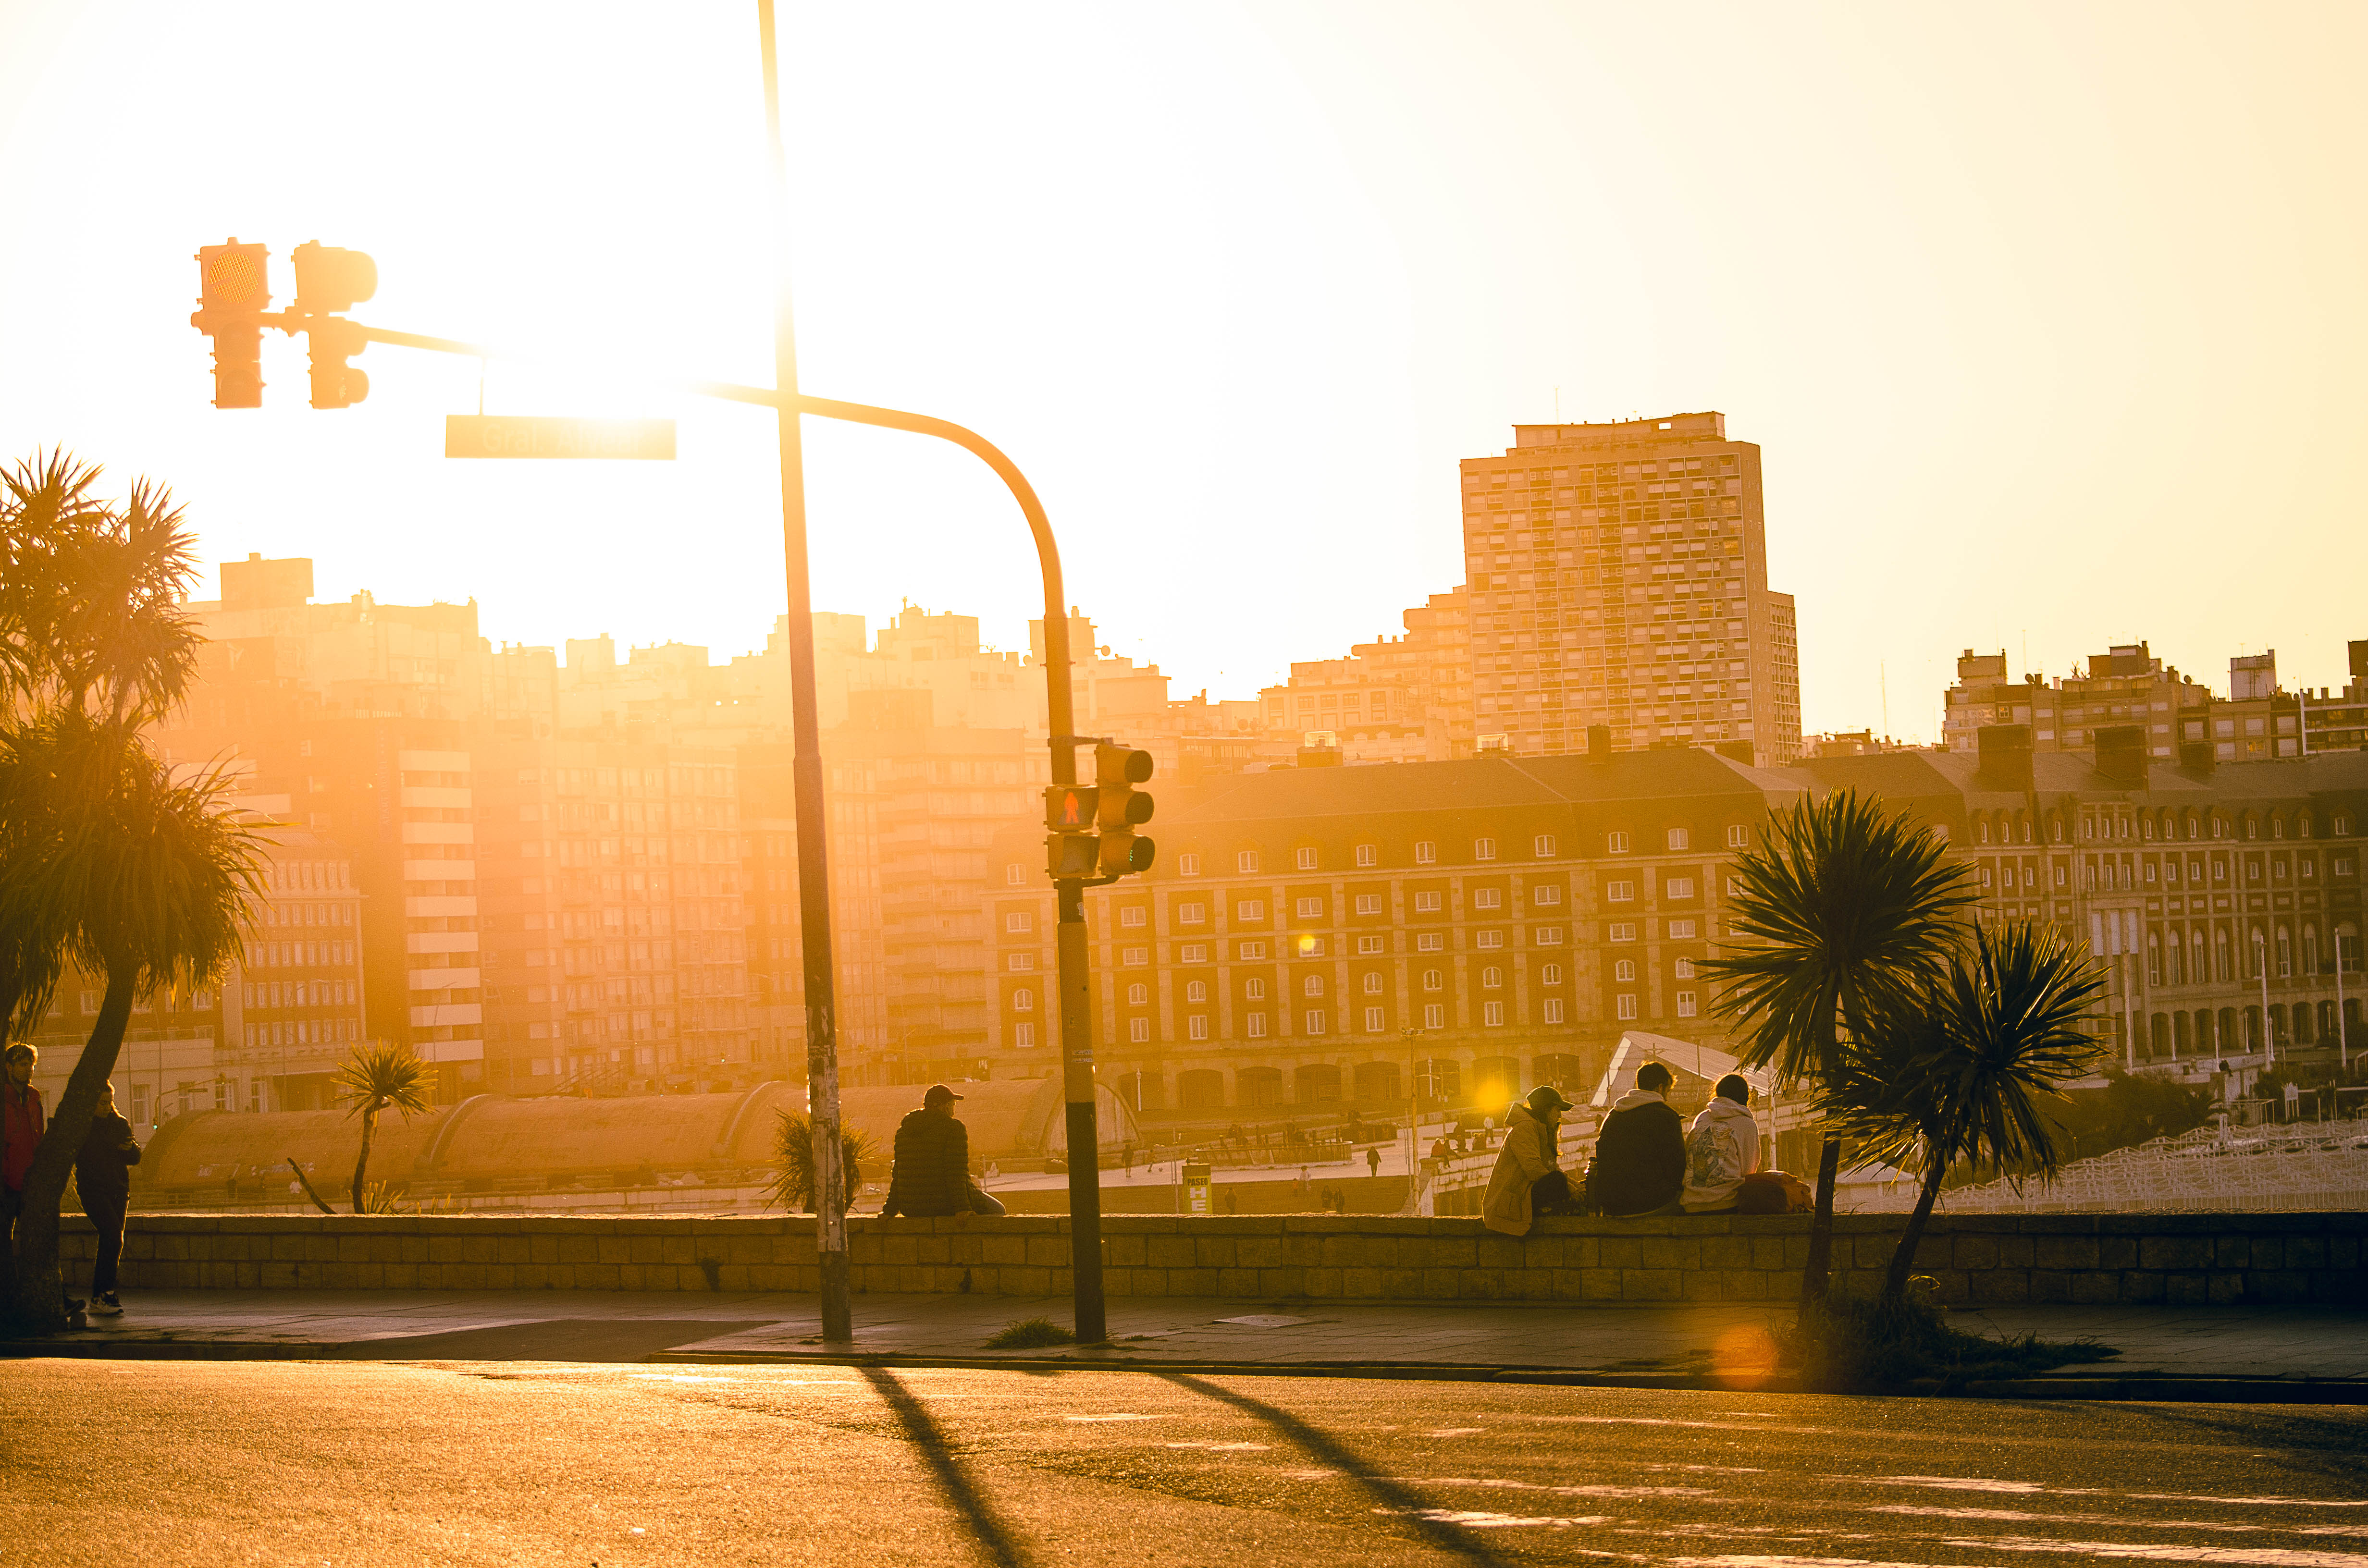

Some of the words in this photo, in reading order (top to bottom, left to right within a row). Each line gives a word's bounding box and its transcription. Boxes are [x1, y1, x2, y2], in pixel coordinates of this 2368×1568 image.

[482, 423, 544, 452] Gral.
[1187, 1177, 1208, 1186] PASEO
[1190, 1187, 1207, 1214] HE
